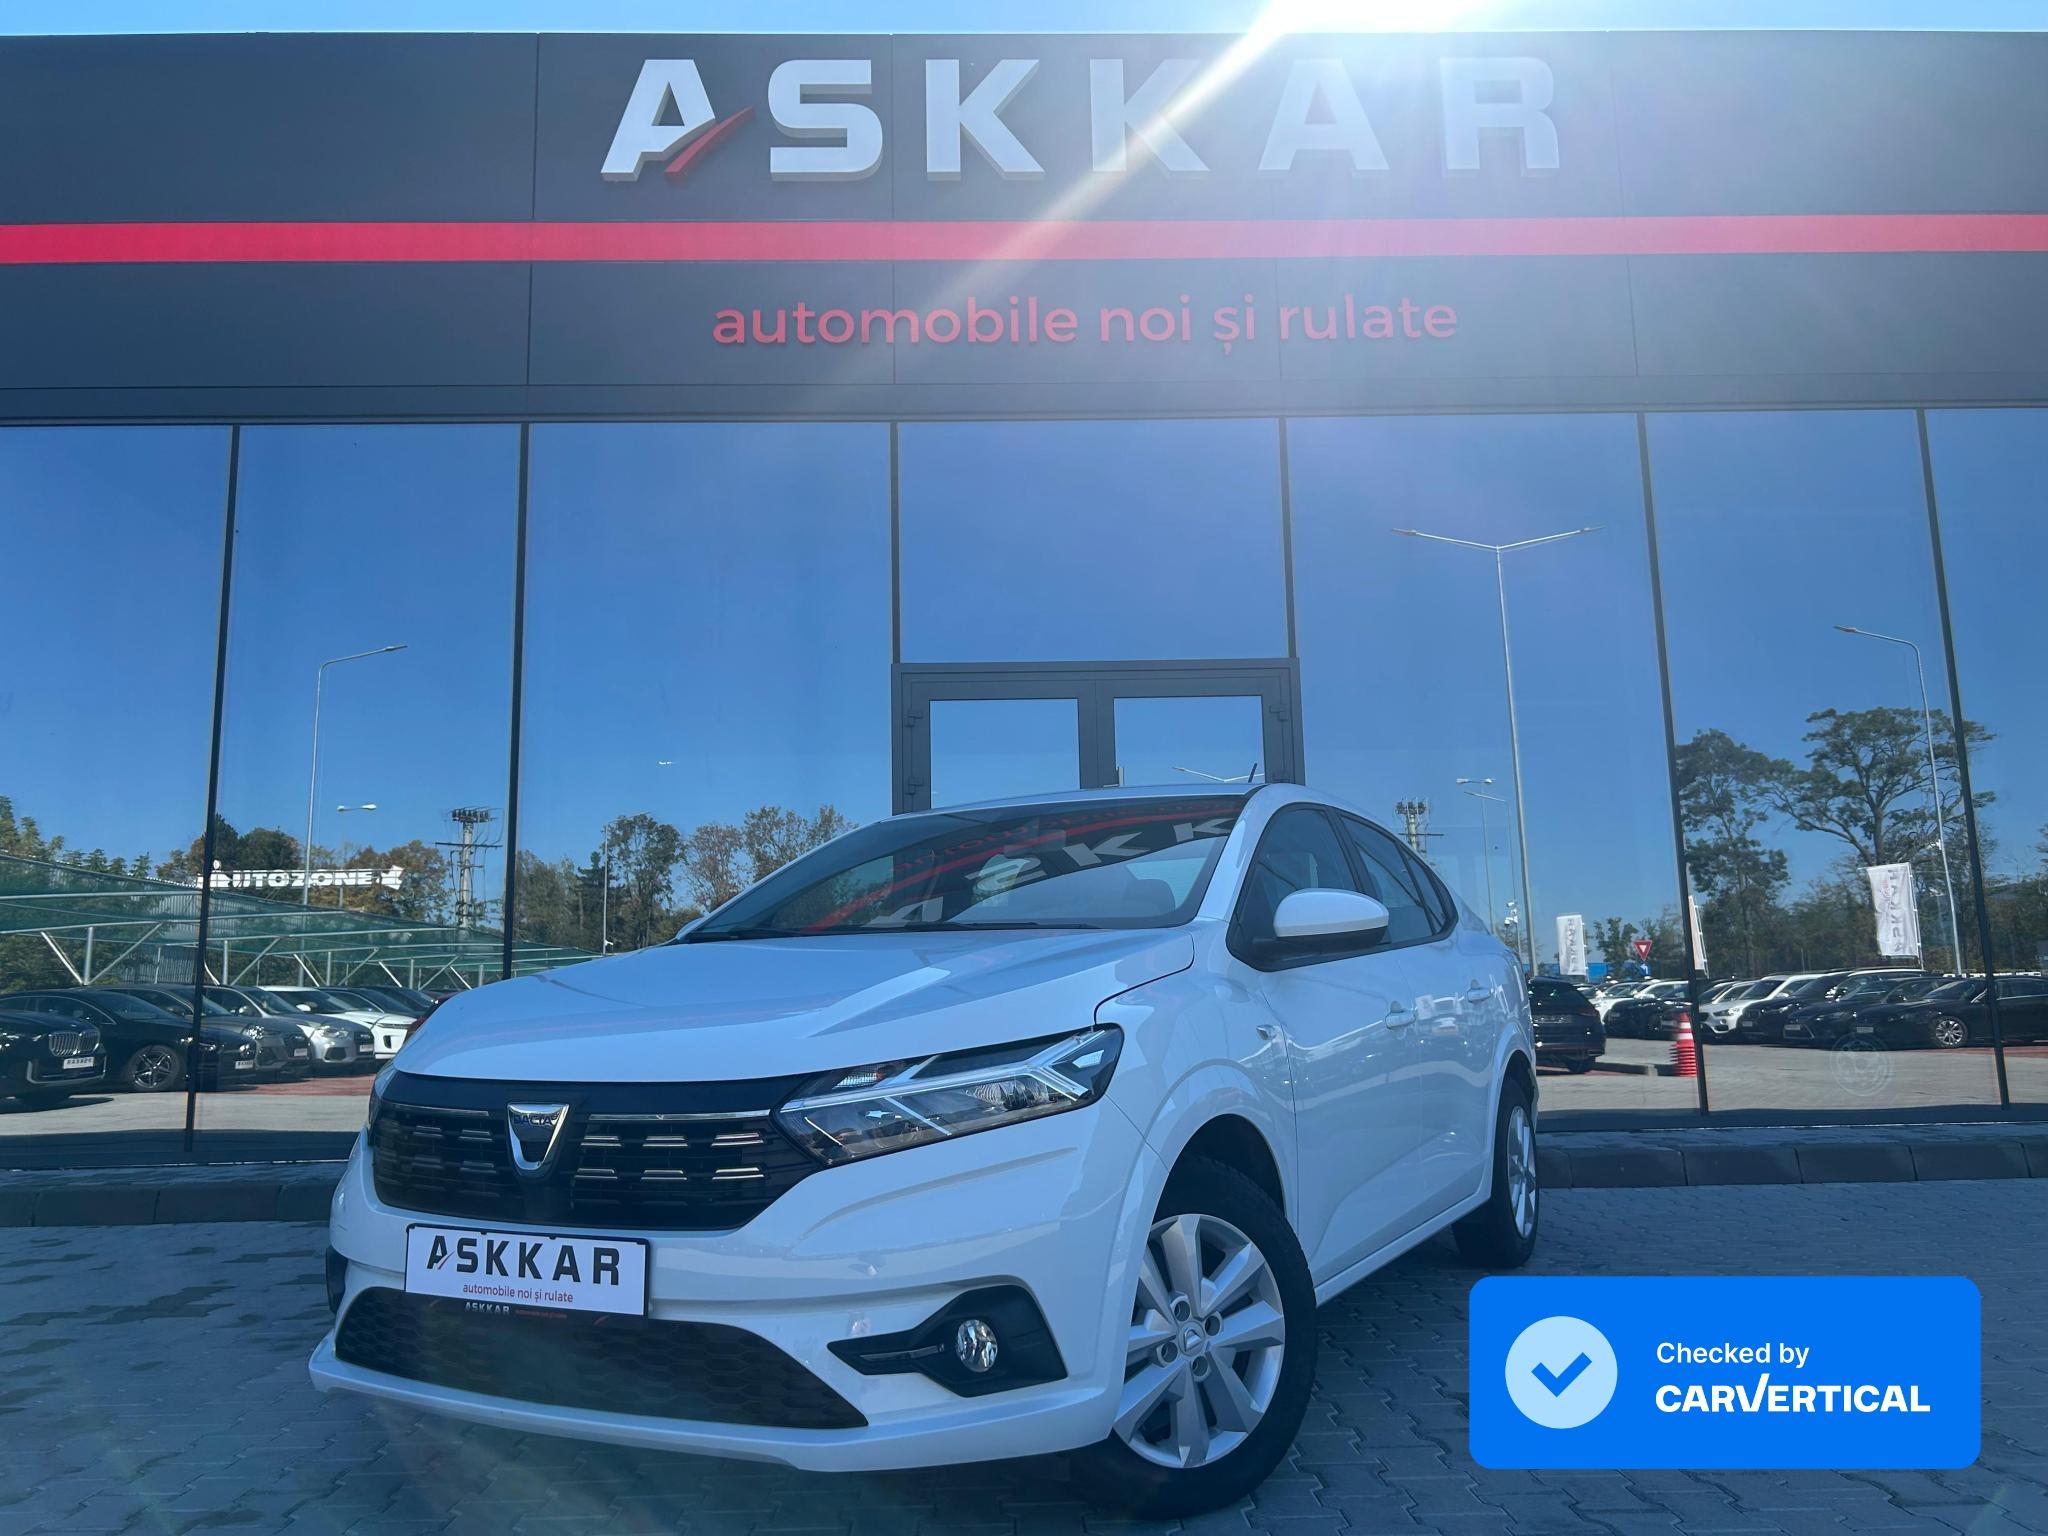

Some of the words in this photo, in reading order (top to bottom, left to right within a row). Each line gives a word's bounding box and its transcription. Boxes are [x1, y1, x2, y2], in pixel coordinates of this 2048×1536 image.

[600, 57, 1561, 182] ASKKAR
[713, 296, 1077, 345] automobile
[1098, 294, 1191, 342] noi
[1212, 292, 1256, 354] și
[1279, 293, 1458, 341] rulate
[427, 1235, 620, 1286] ASKKAR
[463, 1284, 515, 1298] automobile
[517, 1288, 533, 1299] noi
[544, 1290, 574, 1303] rulate
